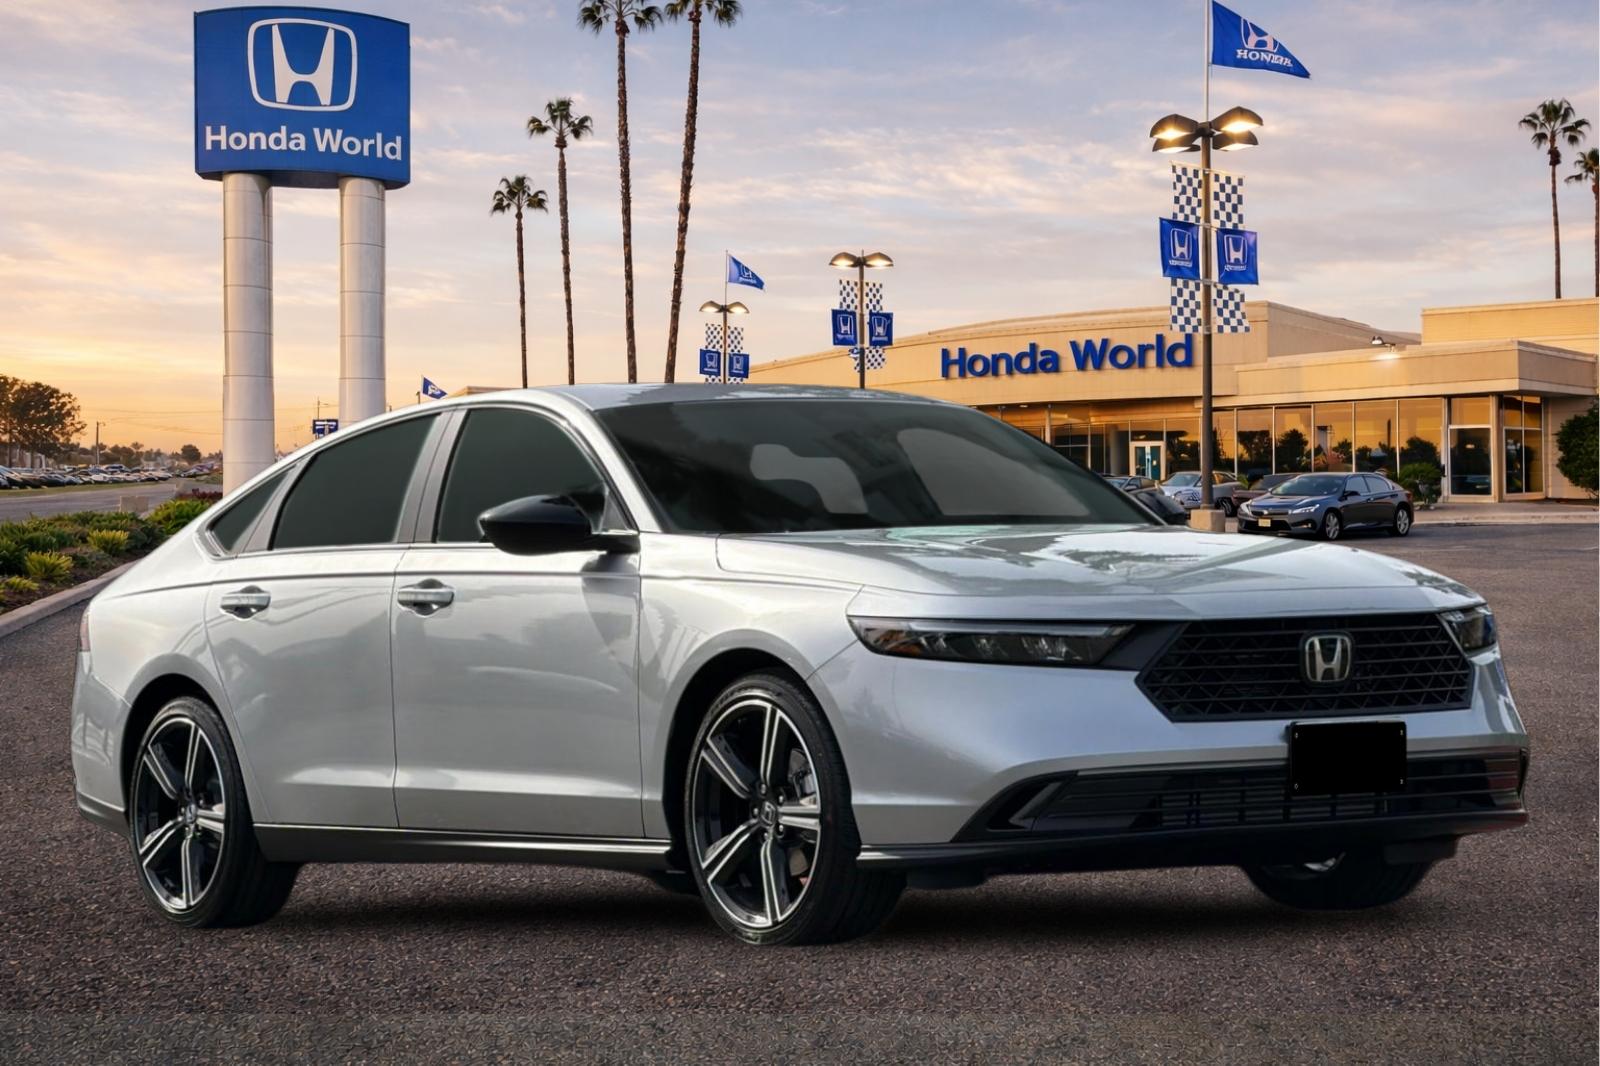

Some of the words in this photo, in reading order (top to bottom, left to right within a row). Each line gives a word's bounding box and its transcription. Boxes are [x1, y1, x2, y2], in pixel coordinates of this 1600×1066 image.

[205, 125, 306, 151] Honda
[313, 127, 402, 161] World
[941, 342, 1060, 378] Honda
[1070, 333, 1194, 371] World
